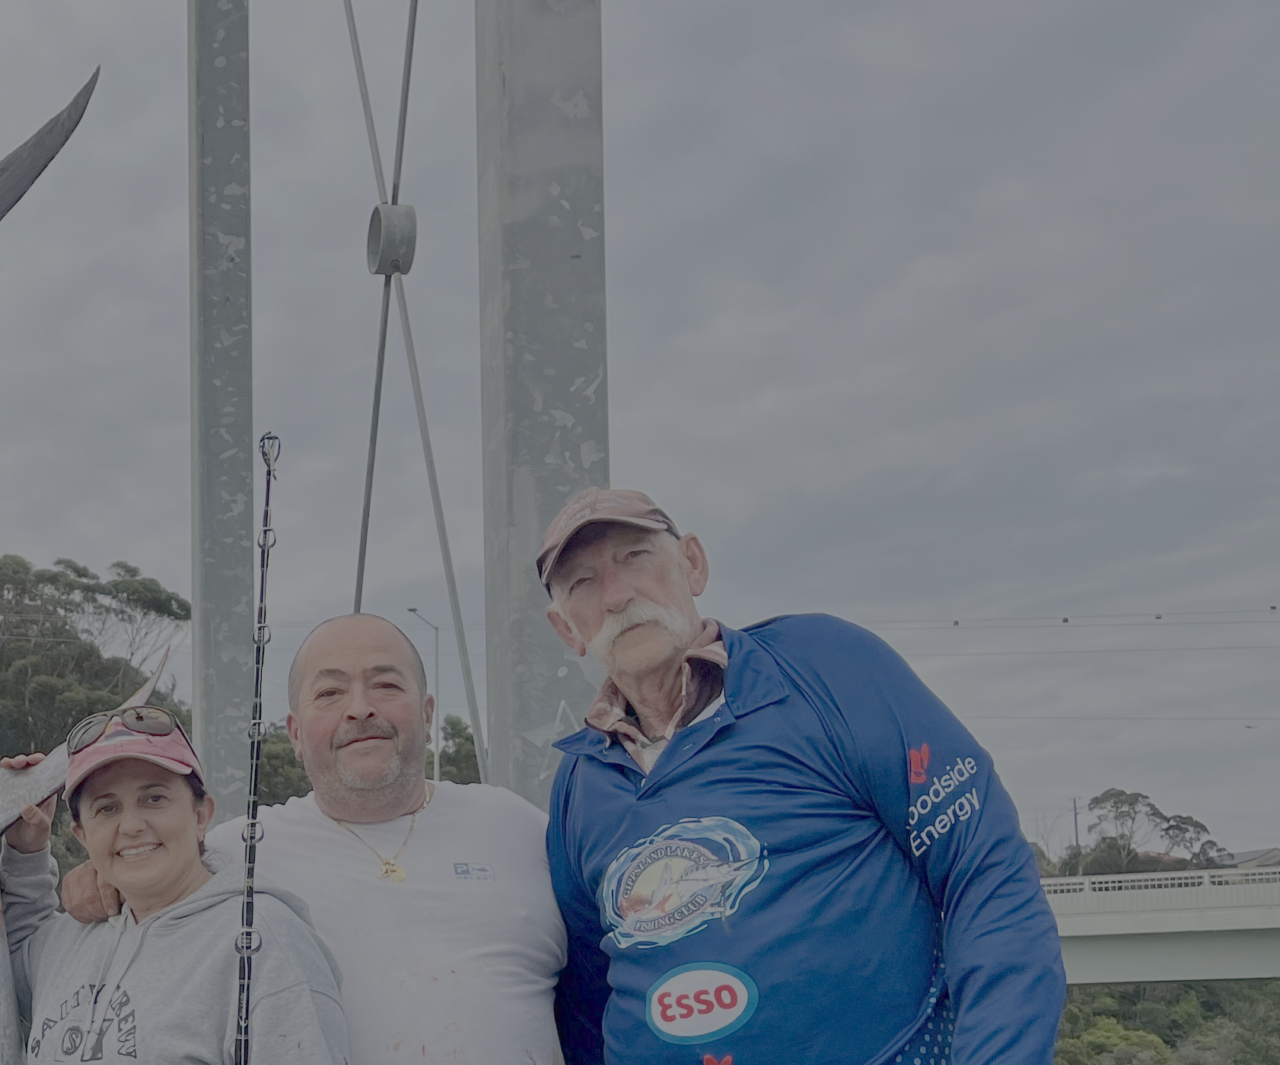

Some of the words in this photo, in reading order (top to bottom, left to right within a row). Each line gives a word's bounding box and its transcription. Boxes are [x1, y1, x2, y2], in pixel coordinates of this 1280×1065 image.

[908, 757, 977, 826] oodside
[910, 787, 980, 858] Energy
[623, 848, 664, 899] GIPPSLAND
[665, 846, 706, 866] LAKES
[636, 911, 675, 931] FISHING
[673, 894, 707, 921] CLUB
[109, 984, 138, 1059] REW
